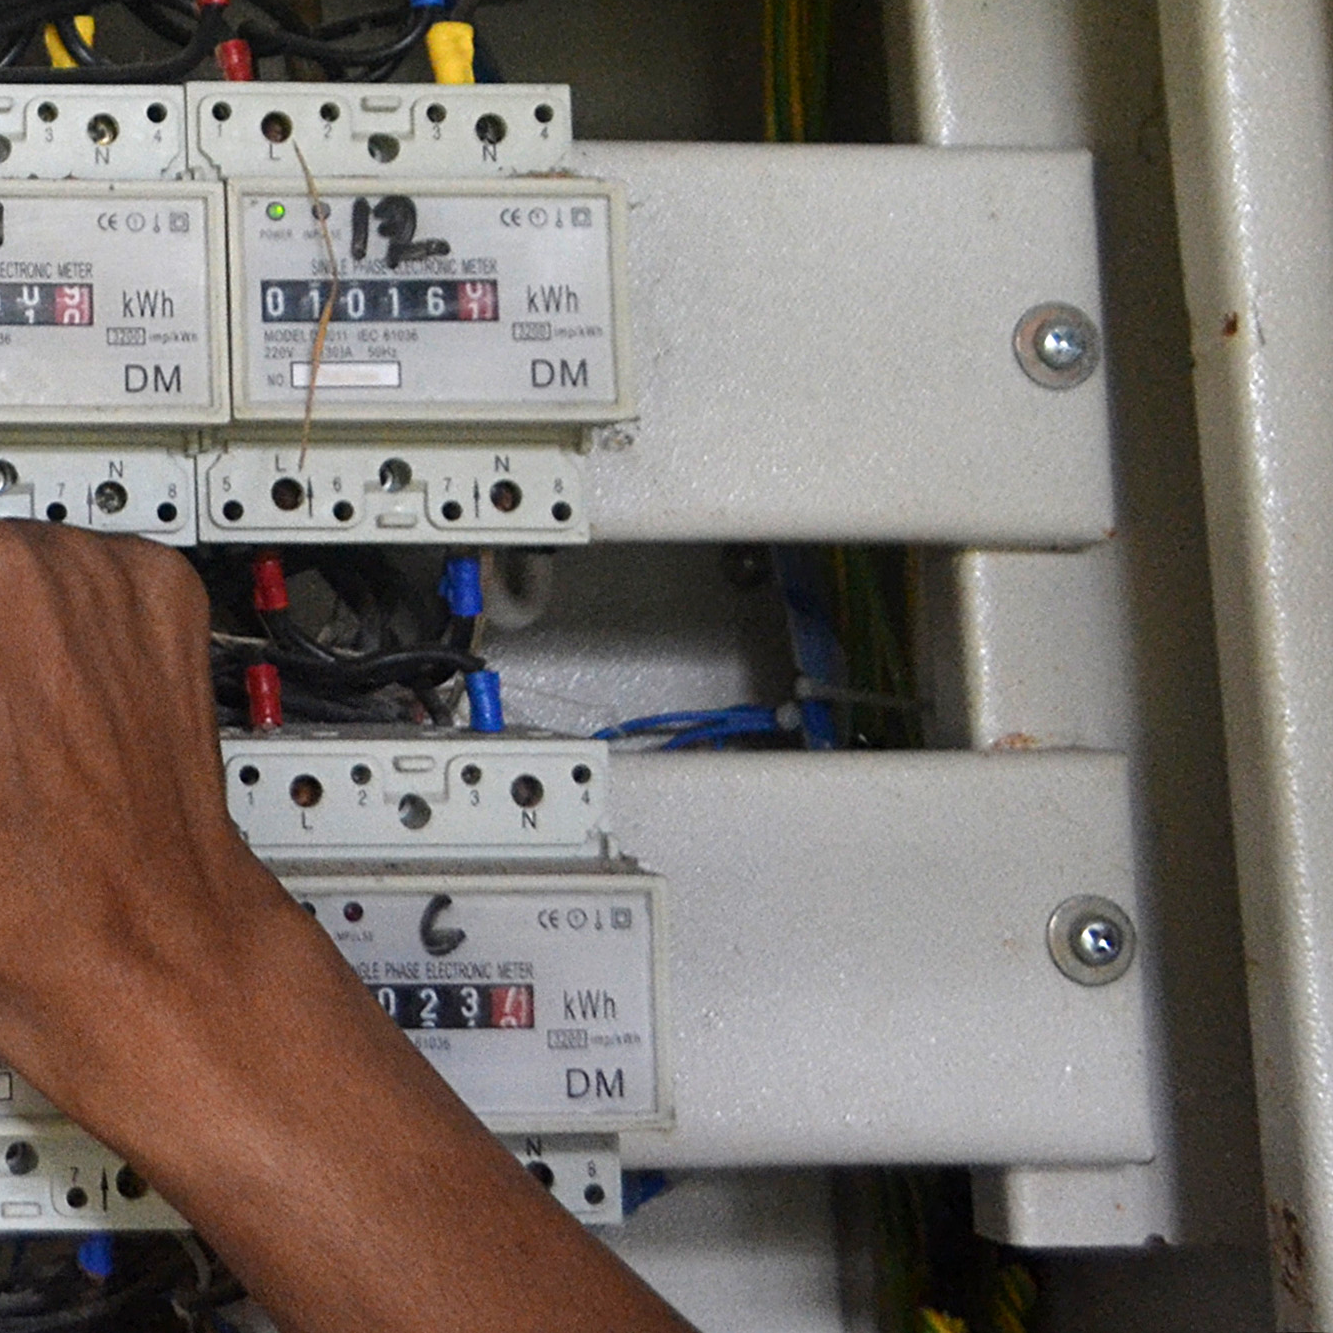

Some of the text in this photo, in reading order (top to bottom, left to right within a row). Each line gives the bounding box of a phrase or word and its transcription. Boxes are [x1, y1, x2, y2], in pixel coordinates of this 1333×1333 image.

[349, 194, 451, 269] 12
[57, 261, 93, 279] METER
[122, 288, 174, 318] kWh
[527, 283, 579, 313] kWh
[123, 363, 181, 393] DM
[530, 358, 588, 387] DM
[563, 988, 617, 1019] kWh
[565, 1067, 624, 1098] DM
